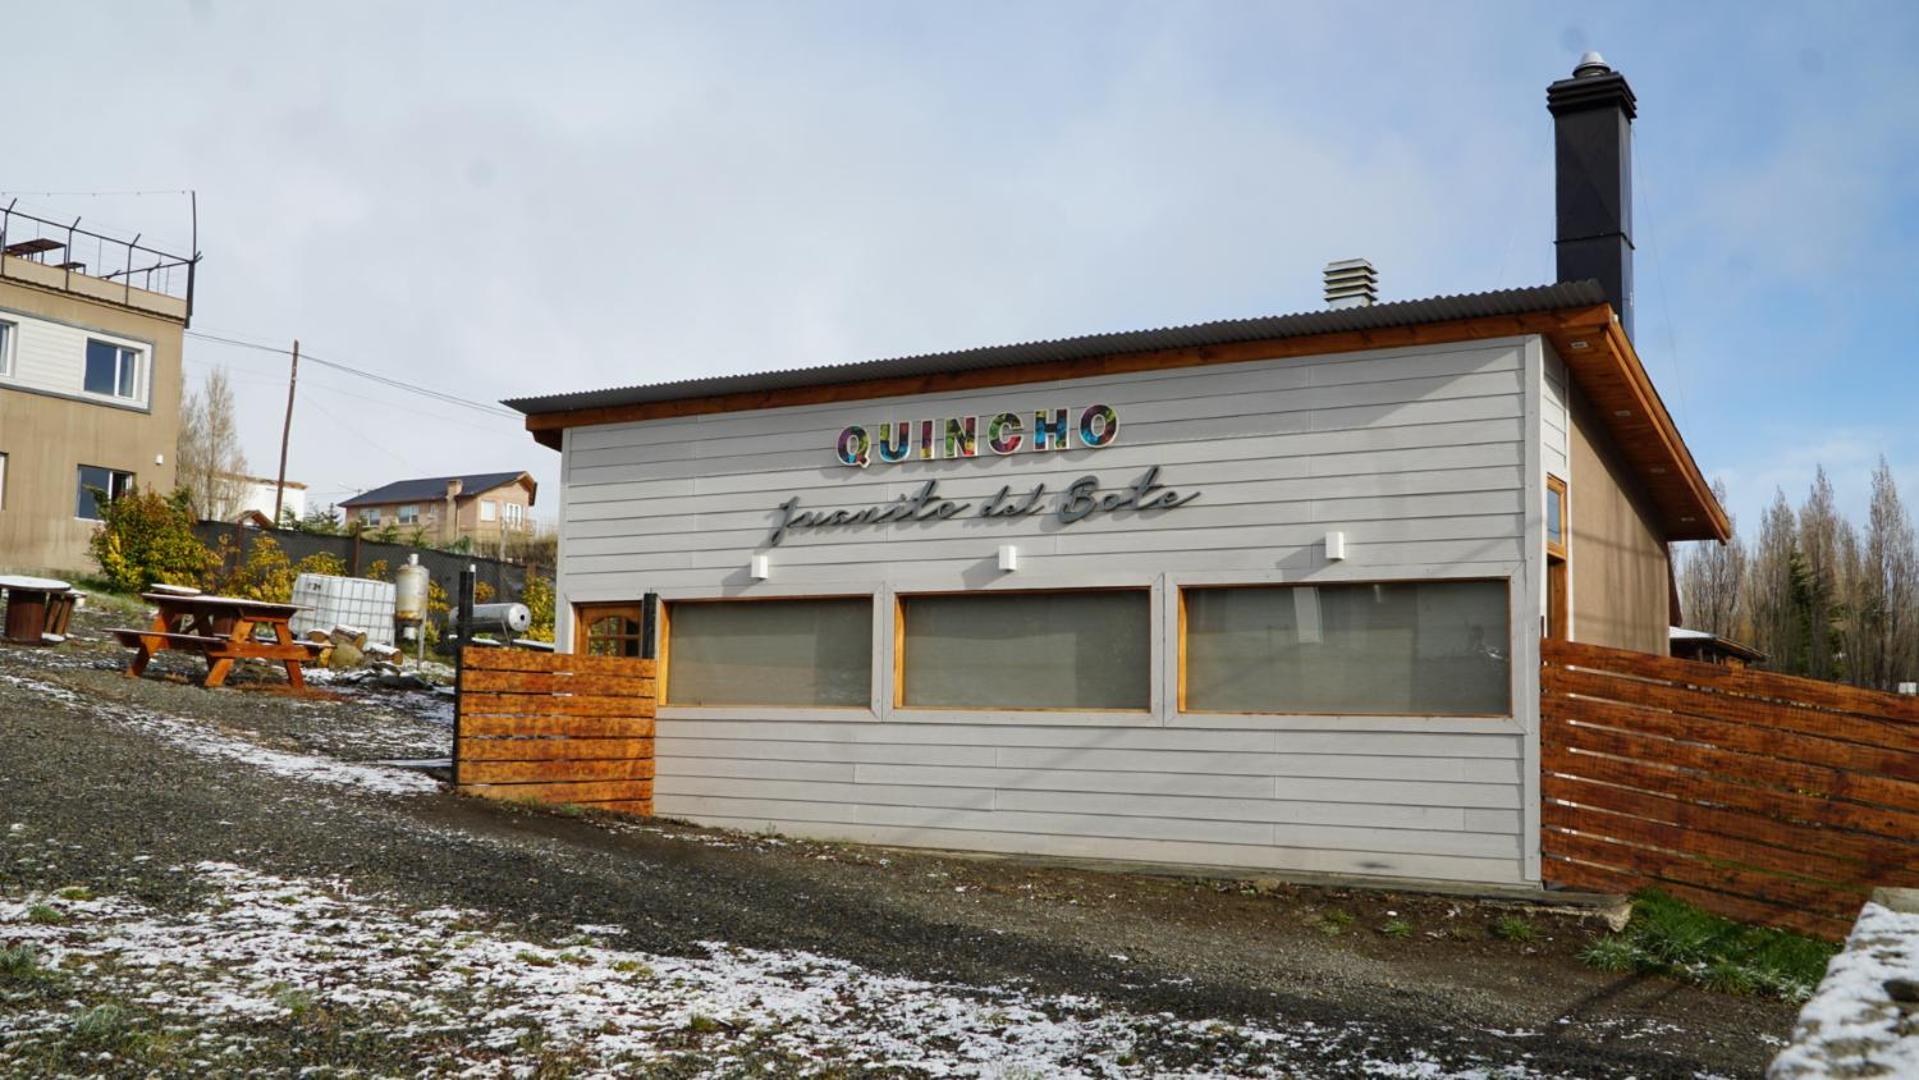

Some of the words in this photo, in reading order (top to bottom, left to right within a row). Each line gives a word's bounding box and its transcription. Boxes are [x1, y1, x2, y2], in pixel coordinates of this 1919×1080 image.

[836, 403, 1120, 468] QUINCHO
[770, 478, 971, 547] Juanito
[979, 482, 1046, 518] del
[1057, 464, 1201, 525] Bote
